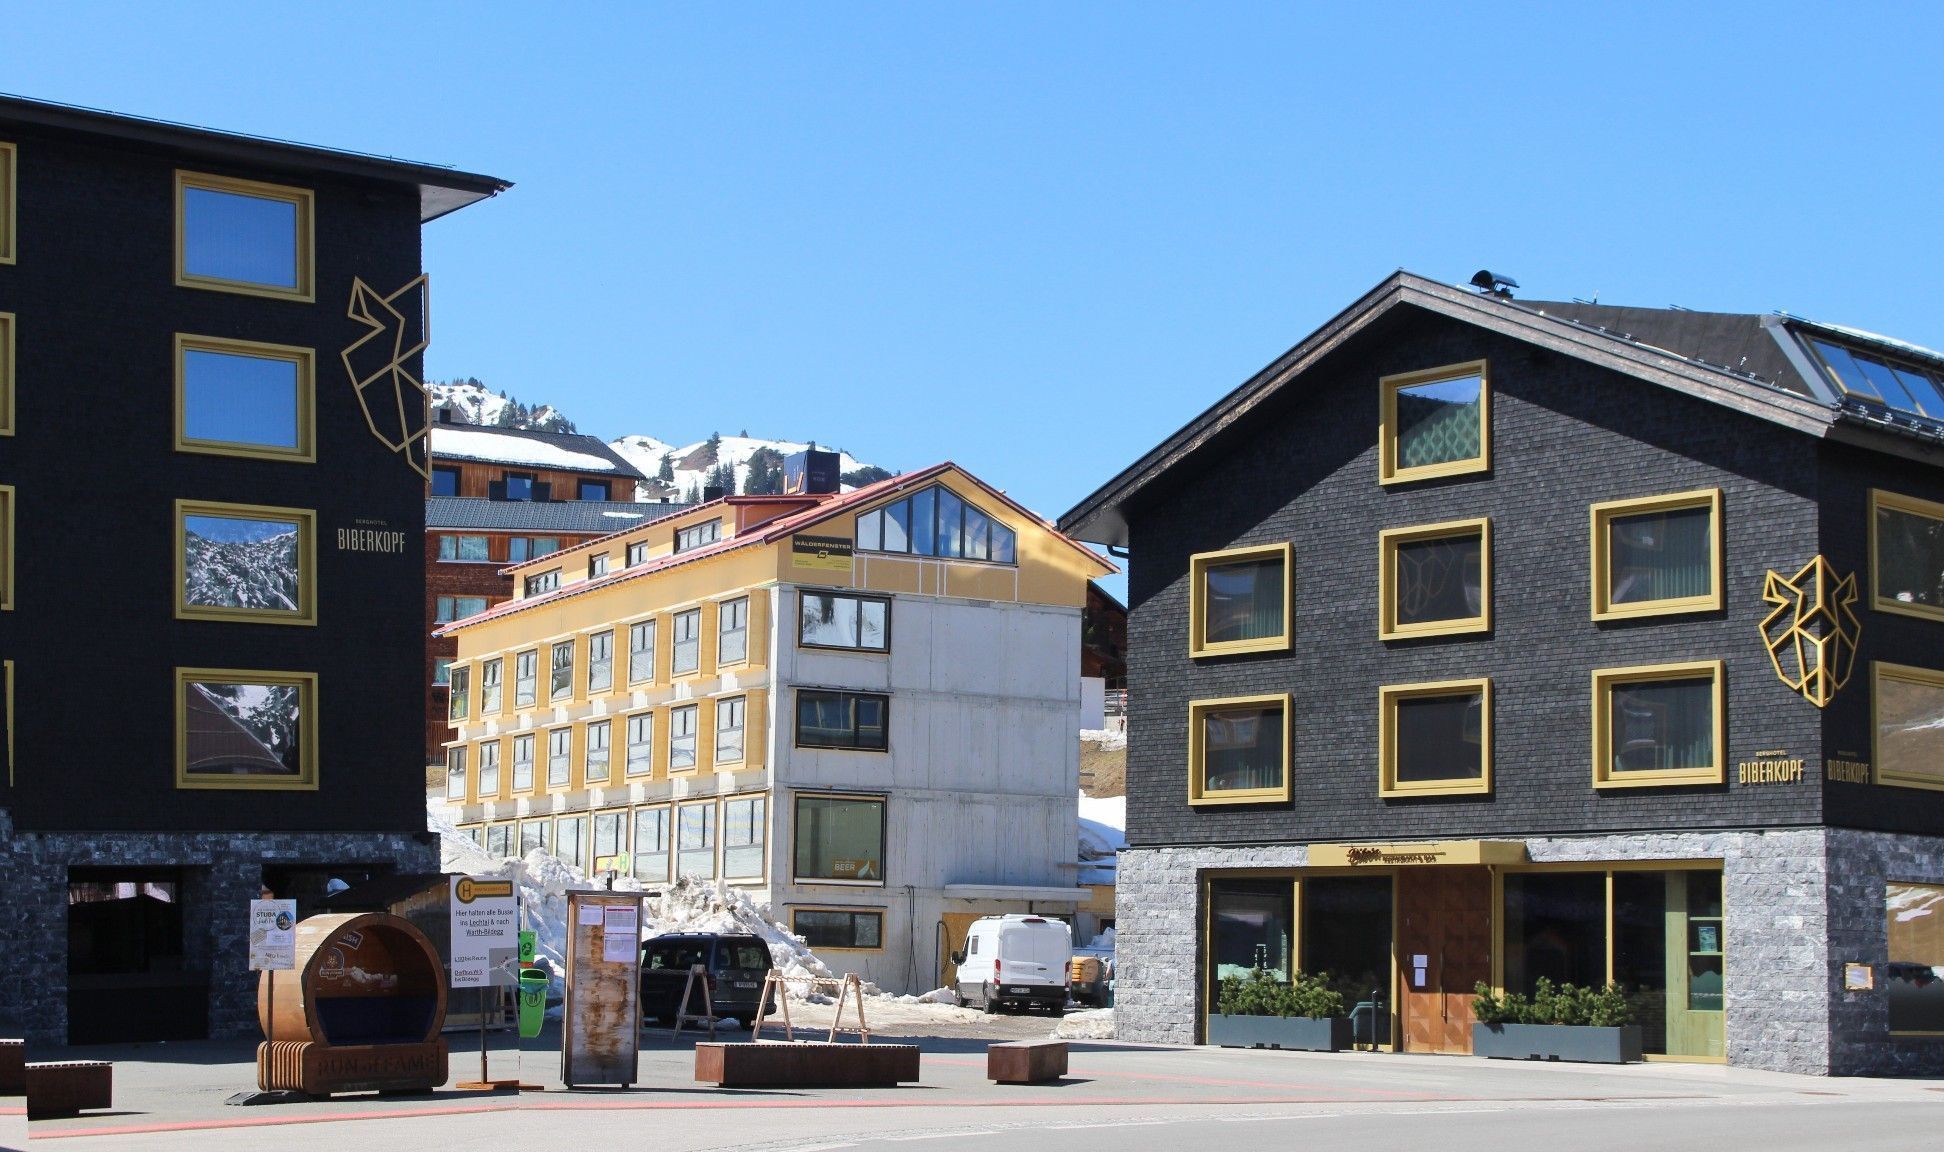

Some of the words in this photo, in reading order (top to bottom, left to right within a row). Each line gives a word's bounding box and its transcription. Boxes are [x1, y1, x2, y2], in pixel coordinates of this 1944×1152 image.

[337, 528, 405, 553] BIBERKOPF
[1739, 759, 1804, 784] BIBERKOPF
[1827, 759, 1870, 784] BIBERKOPF
[834, 863, 856, 871] BEER
[462, 884, 471, 897] H
[455, 909, 467, 917] Hier
